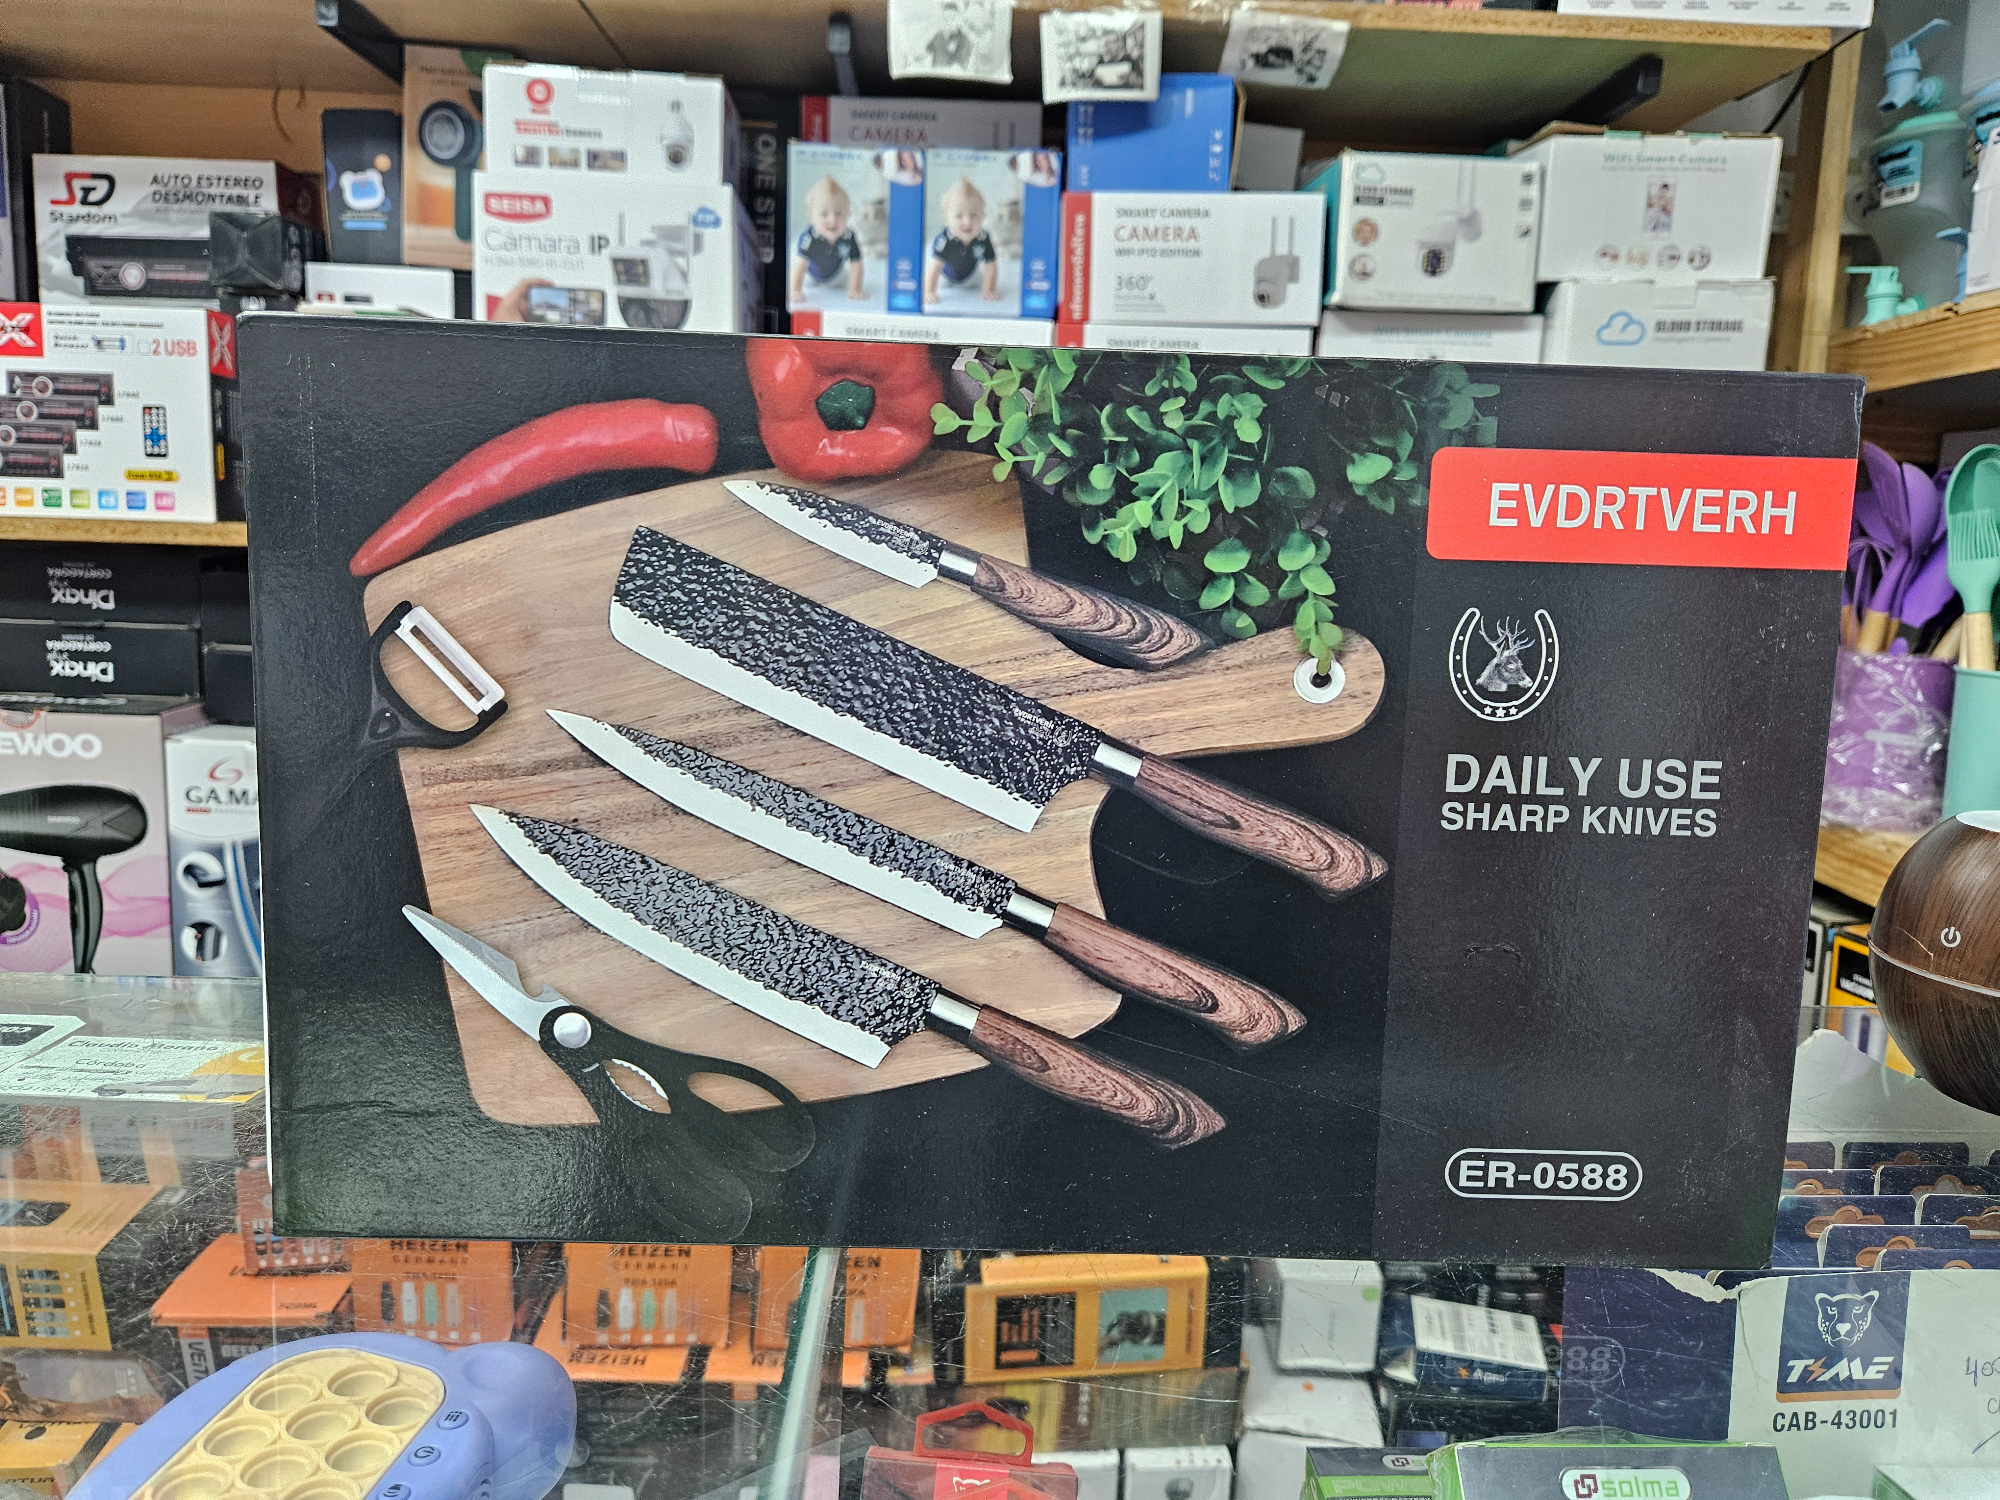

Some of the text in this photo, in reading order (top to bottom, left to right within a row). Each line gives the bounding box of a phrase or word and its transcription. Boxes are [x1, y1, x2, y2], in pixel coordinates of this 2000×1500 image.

[851, 127, 928, 143] CAMERA
[150, 173, 264, 190] AUTO ESTEREO
[152, 190, 263, 206] DESMONTABLE
[488, 197, 549, 216] SEISA
[49, 210, 118, 223] Stardom
[1115, 208, 1212, 219] SMART CAMERA
[485, 226, 610, 256] Cámara IP
[1114, 225, 1200, 243] CAMERA
[152, 338, 198, 357] 2 USB
[1489, 482, 1797, 535] EVDRTVERH
[51, 588, 116, 610] Dinax
[45, 639, 112, 652] CORTADORA
[50, 661, 115, 683] Dinax
[1445, 754, 1723, 800] DAILY USE
[1440, 802, 1717, 837] SHARP KNIVES
[68, 1040, 140, 1049] Claudio
[1459, 1160, 1628, 1191] ER-0588
[391, 1240, 469, 1252] HEIZEN
[610, 1244, 691, 1258] HEIZEN
[570, 1351, 648, 1367] HEIZEN
[1773, 1408, 1898, 1433] CAB-43001
[1600, 1475, 1680, 1500] solma
